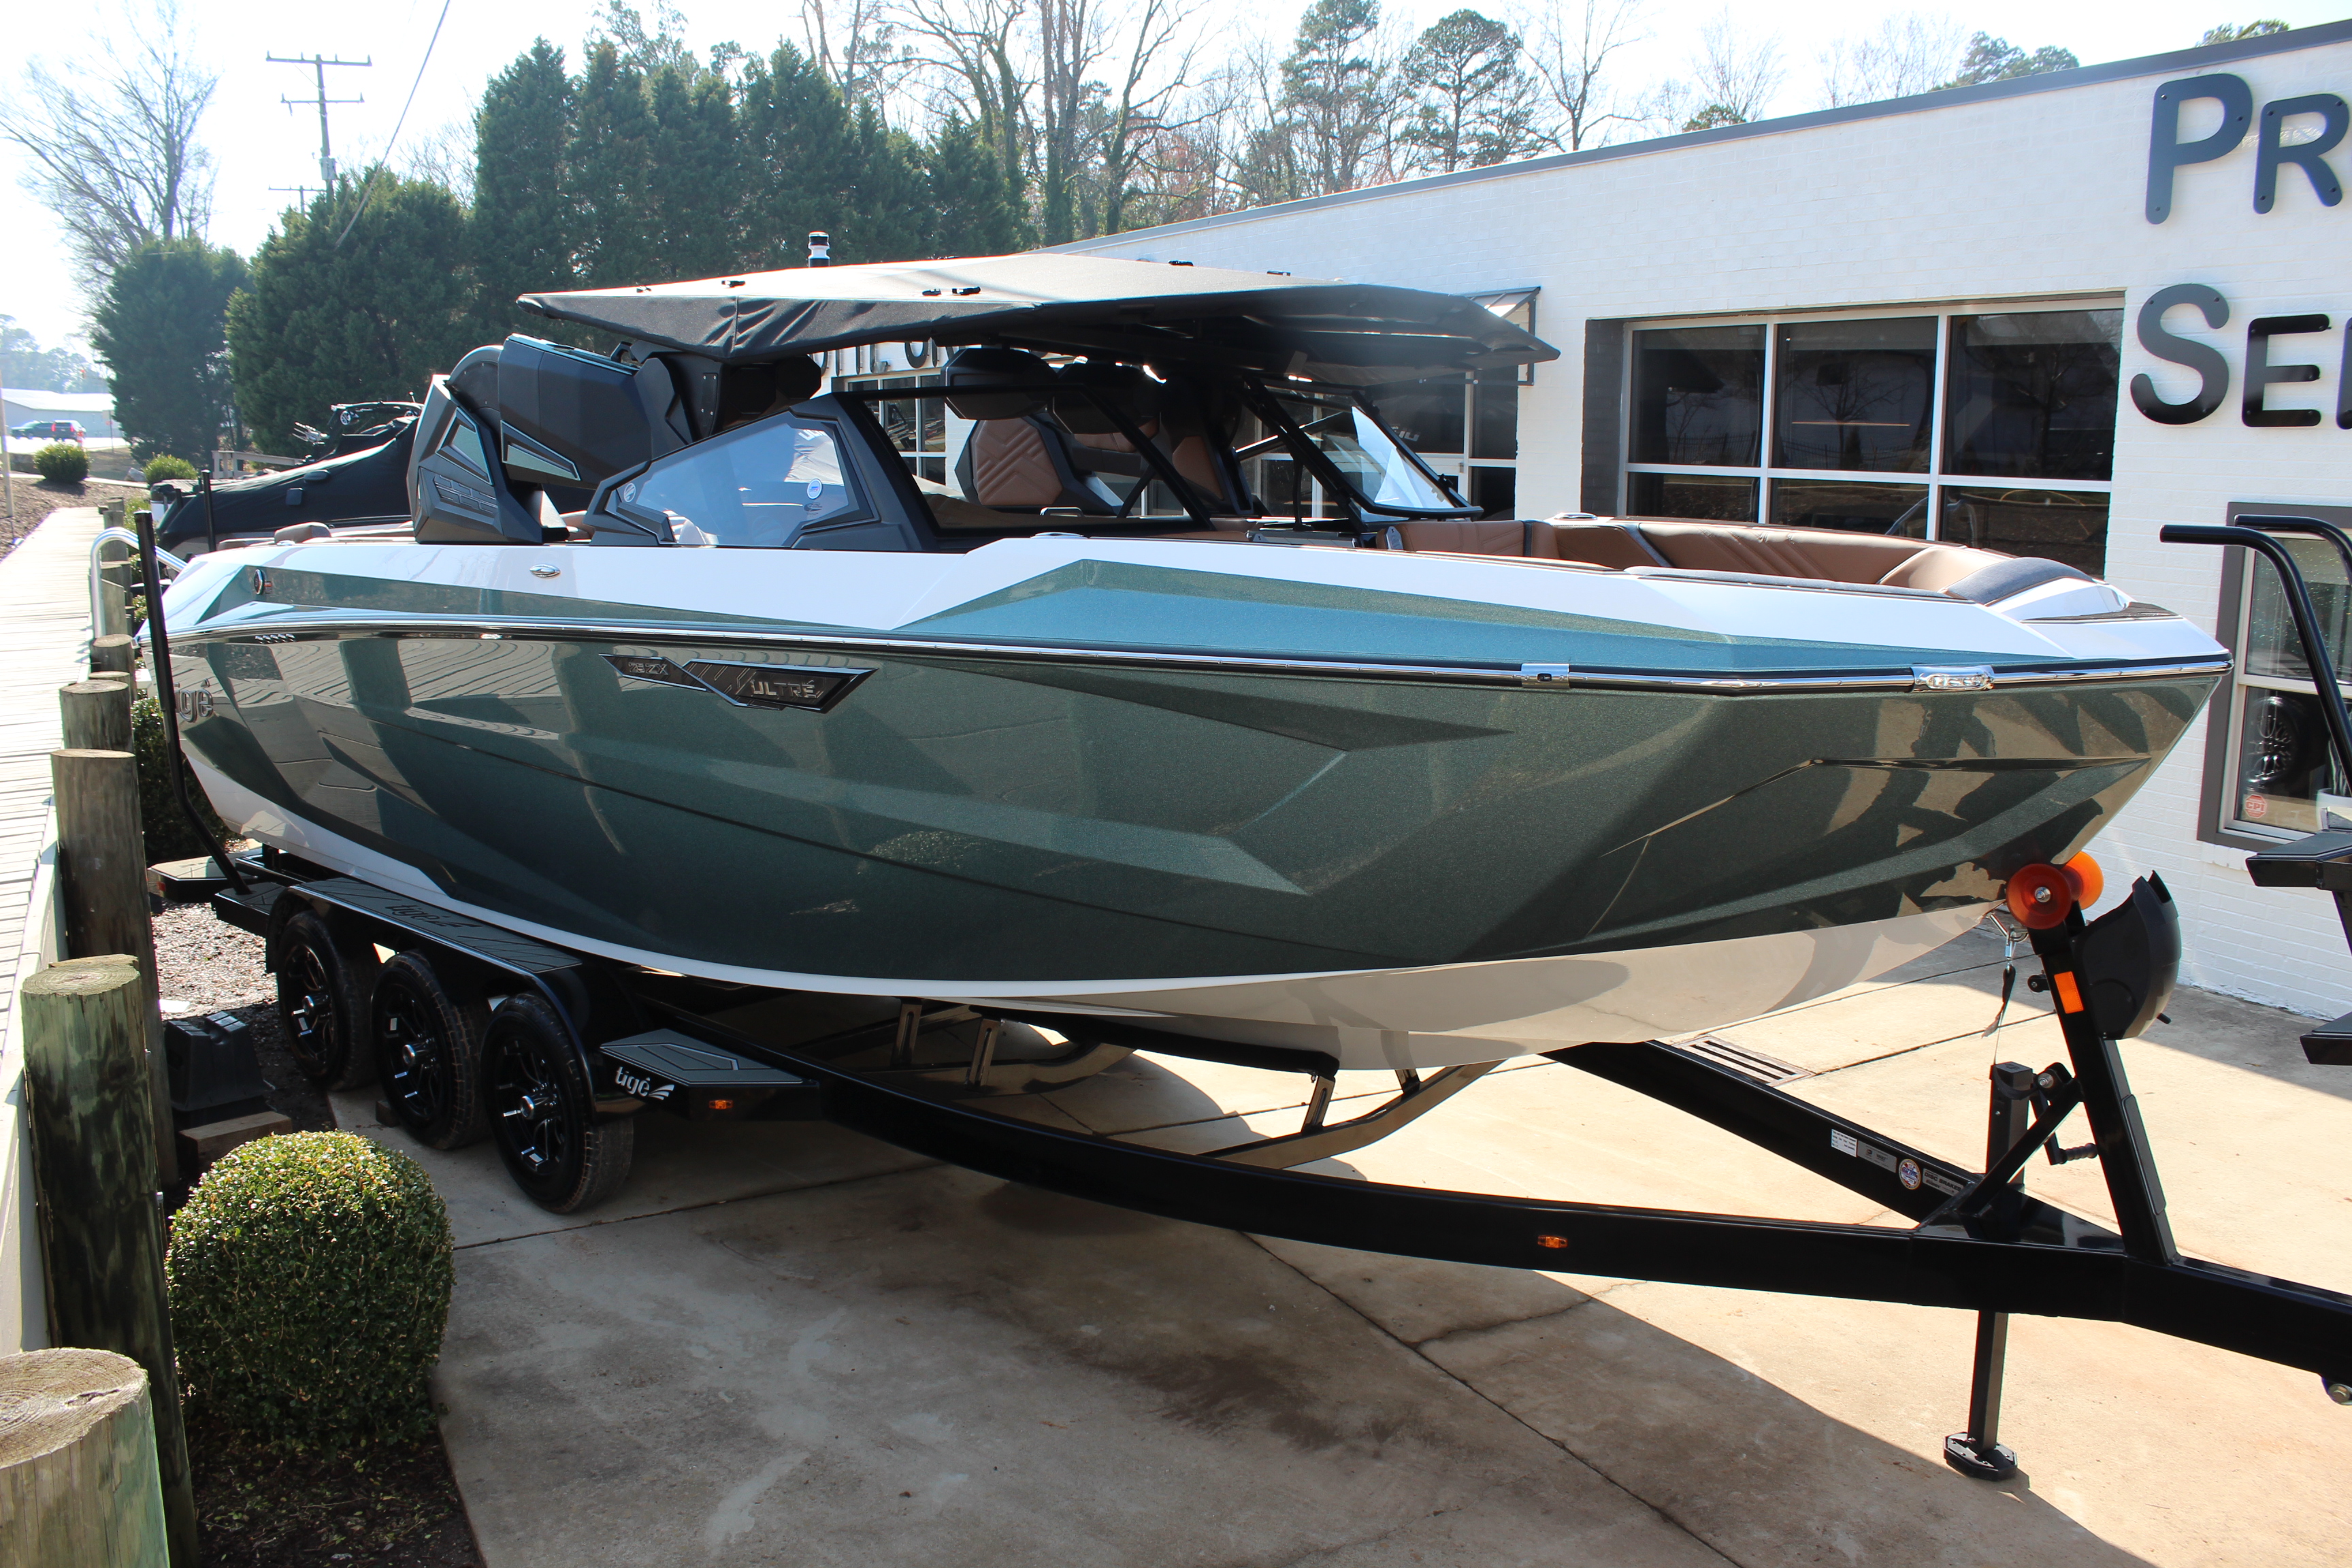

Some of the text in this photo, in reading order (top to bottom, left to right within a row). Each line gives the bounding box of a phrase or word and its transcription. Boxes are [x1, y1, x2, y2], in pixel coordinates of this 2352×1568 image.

[2145, 73, 2352, 225] PR
[2130, 283, 2352, 430] SE
[173, 678, 214, 723] igé
[2246, 801, 2265, 811] CPI
[615, 1066, 651, 1097] tigé
[1924, 1171, 1938, 1181] DISC
[1938, 1178, 1963, 1192] BRAKES
